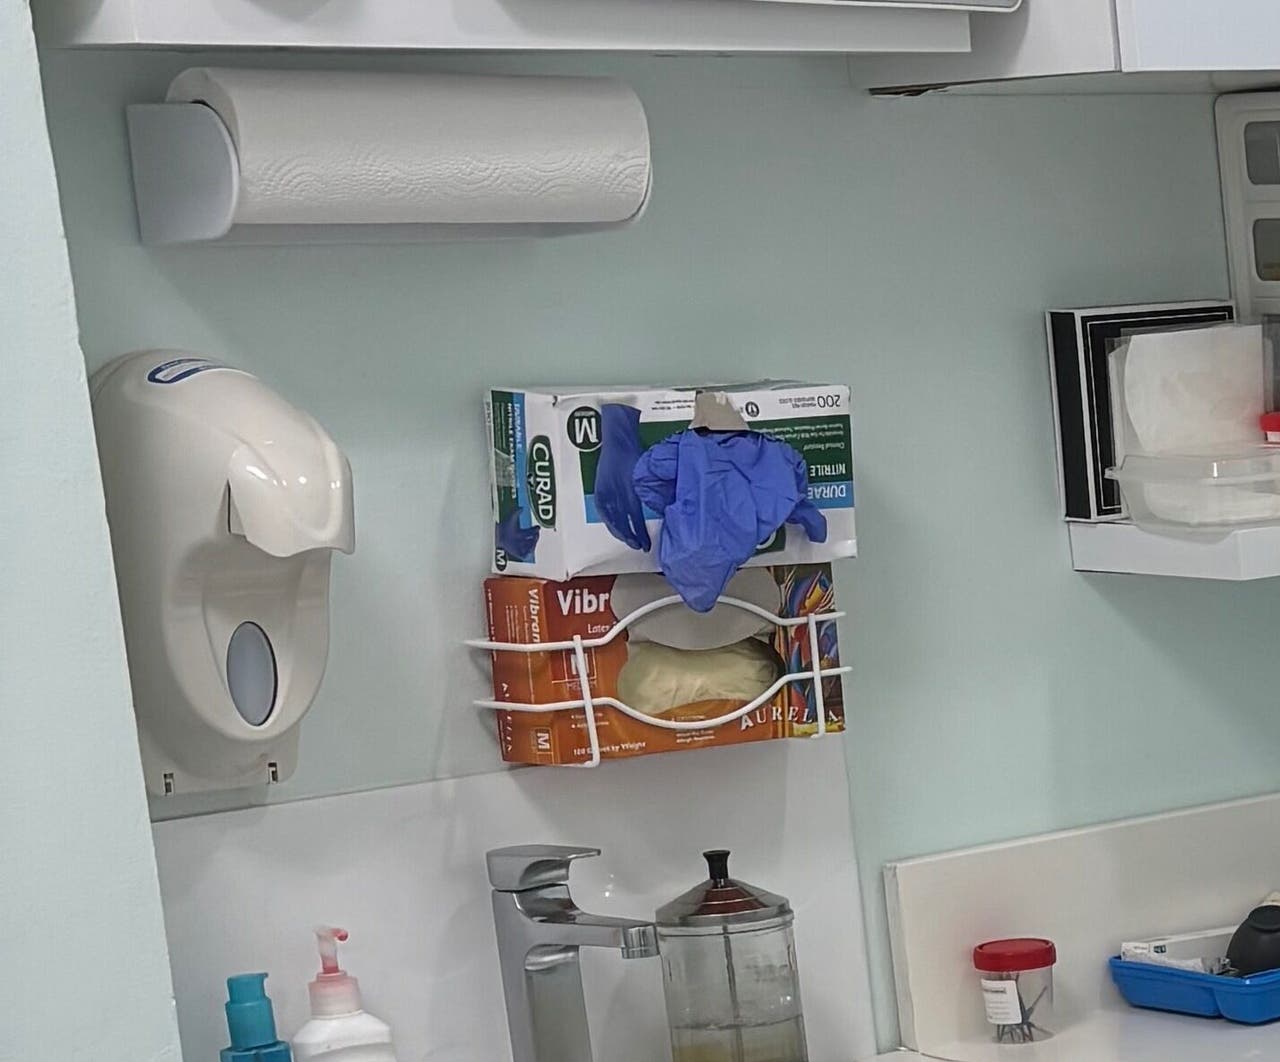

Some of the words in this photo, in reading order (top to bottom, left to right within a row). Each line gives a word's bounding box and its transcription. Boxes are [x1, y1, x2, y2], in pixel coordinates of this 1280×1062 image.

[817, 394, 840, 408] 200
[574, 416, 599, 444] M
[533, 442, 553, 520] CURAD
[810, 463, 846, 477] NITRILE
[807, 484, 846, 500] DURAB
[496, 549, 506, 565] M
[556, 588, 610, 616] Vibr
[528, 588, 541, 644] Vibran
[740, 706, 842, 732] AURELA
[537, 732, 550, 750] M
